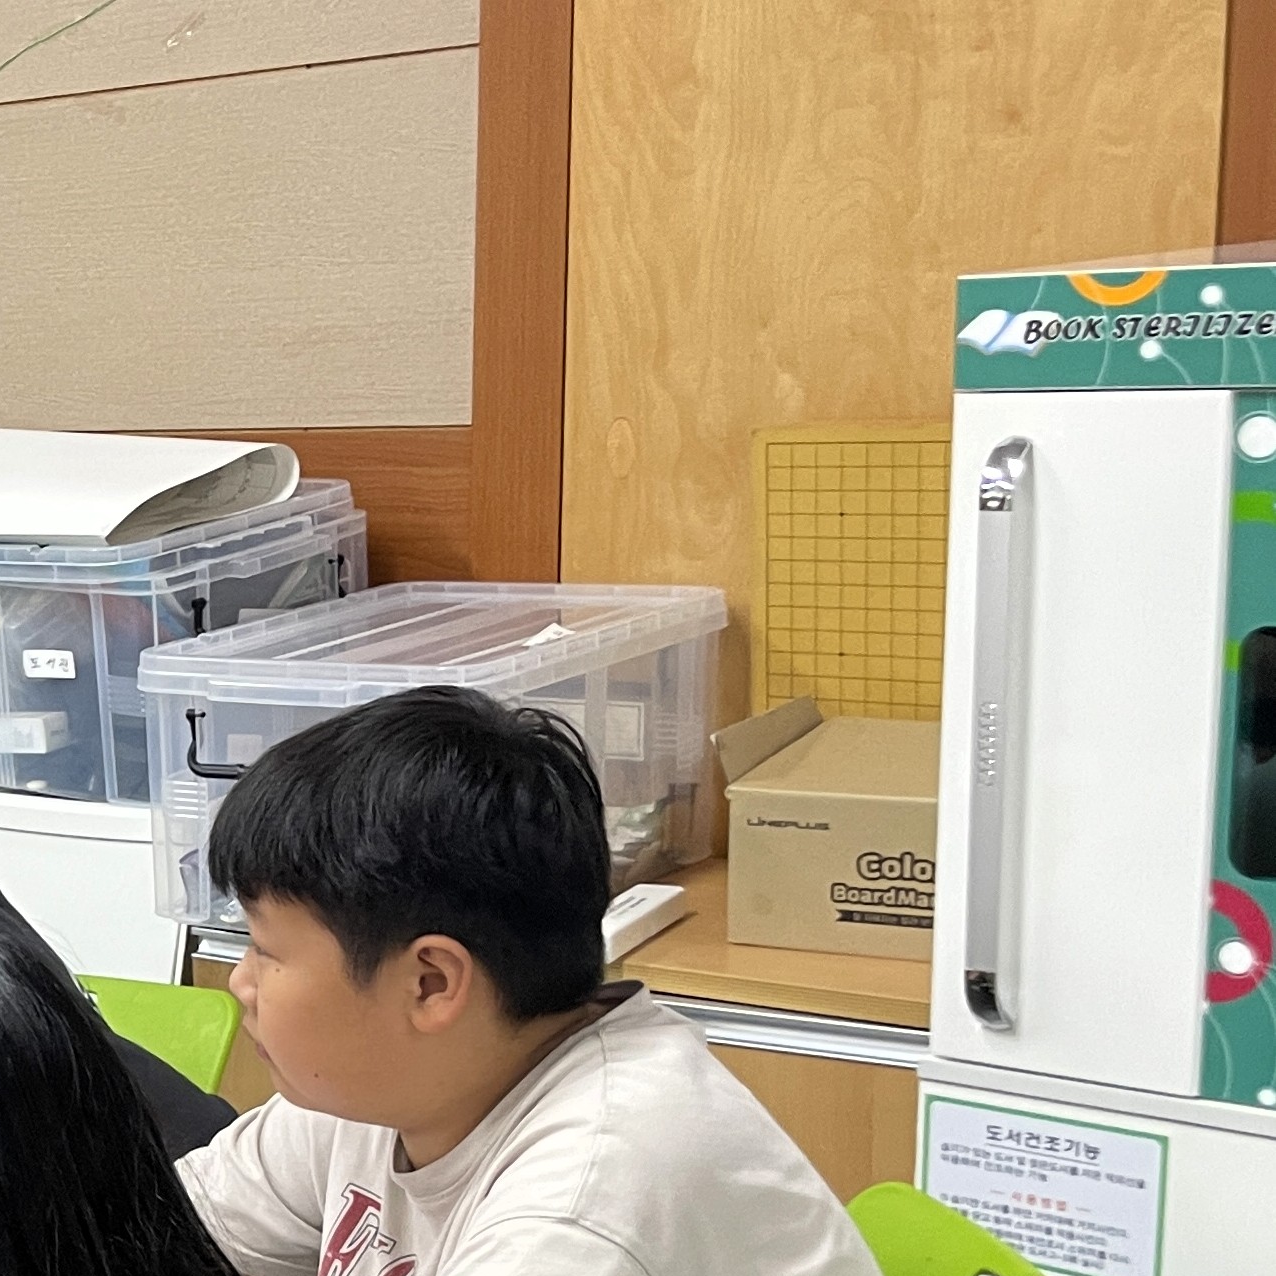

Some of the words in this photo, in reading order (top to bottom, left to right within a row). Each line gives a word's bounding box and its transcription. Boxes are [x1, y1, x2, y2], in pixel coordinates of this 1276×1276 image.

[1023, 315, 1103, 345] BOOK
[1111, 310, 1276, 340] STERILIZE
[856, 851, 935, 883] Colo
[985, 1124, 1102, 1161] 도서건조기능
